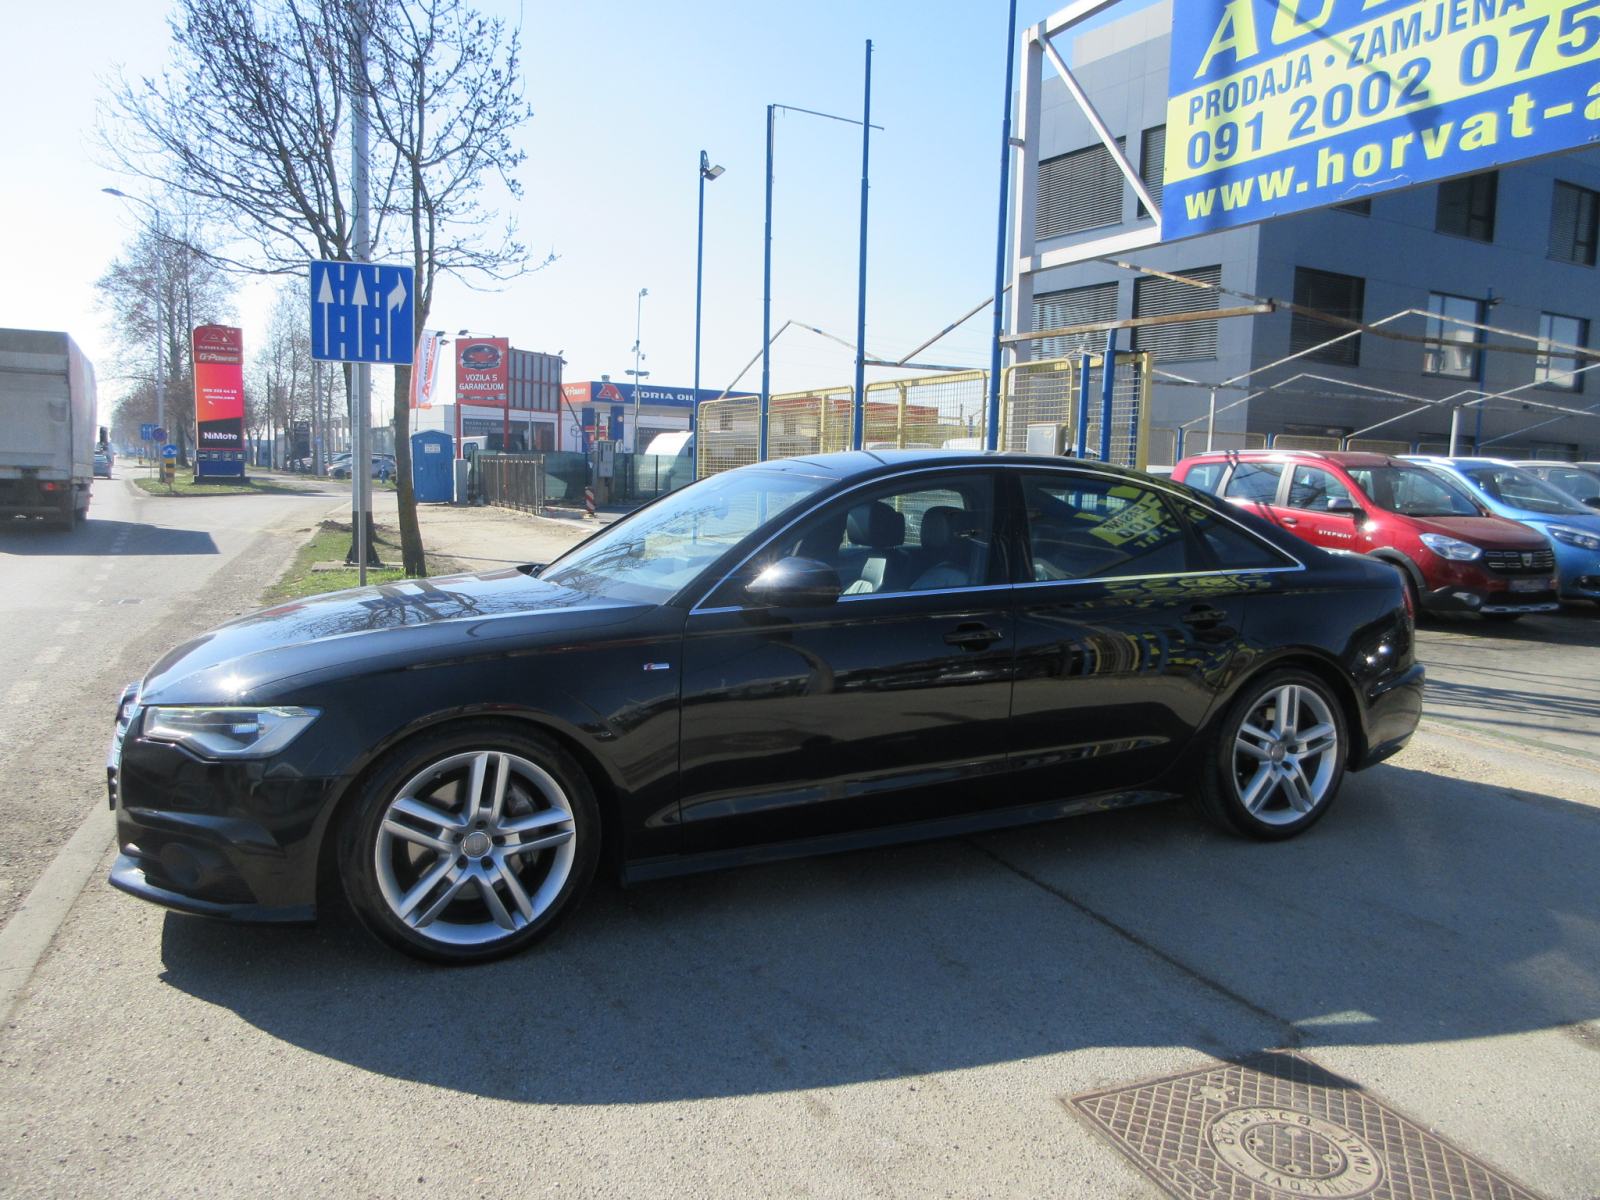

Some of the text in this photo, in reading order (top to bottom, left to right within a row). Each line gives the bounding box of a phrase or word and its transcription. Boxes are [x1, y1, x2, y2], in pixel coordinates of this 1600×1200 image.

[1188, 54, 1312, 126] PRODAJA
[1187, 118, 1264, 170] 091
[1288, 57, 1432, 140] 2002
[465, 373, 490, 381] VOZILA
[459, 383, 504, 391] GARANCIJOM
[631, 390, 695, 401] ADRIA OIL
[204, 432, 238, 440] NiMote
[1318, 529, 1352, 539] STEPWAY
